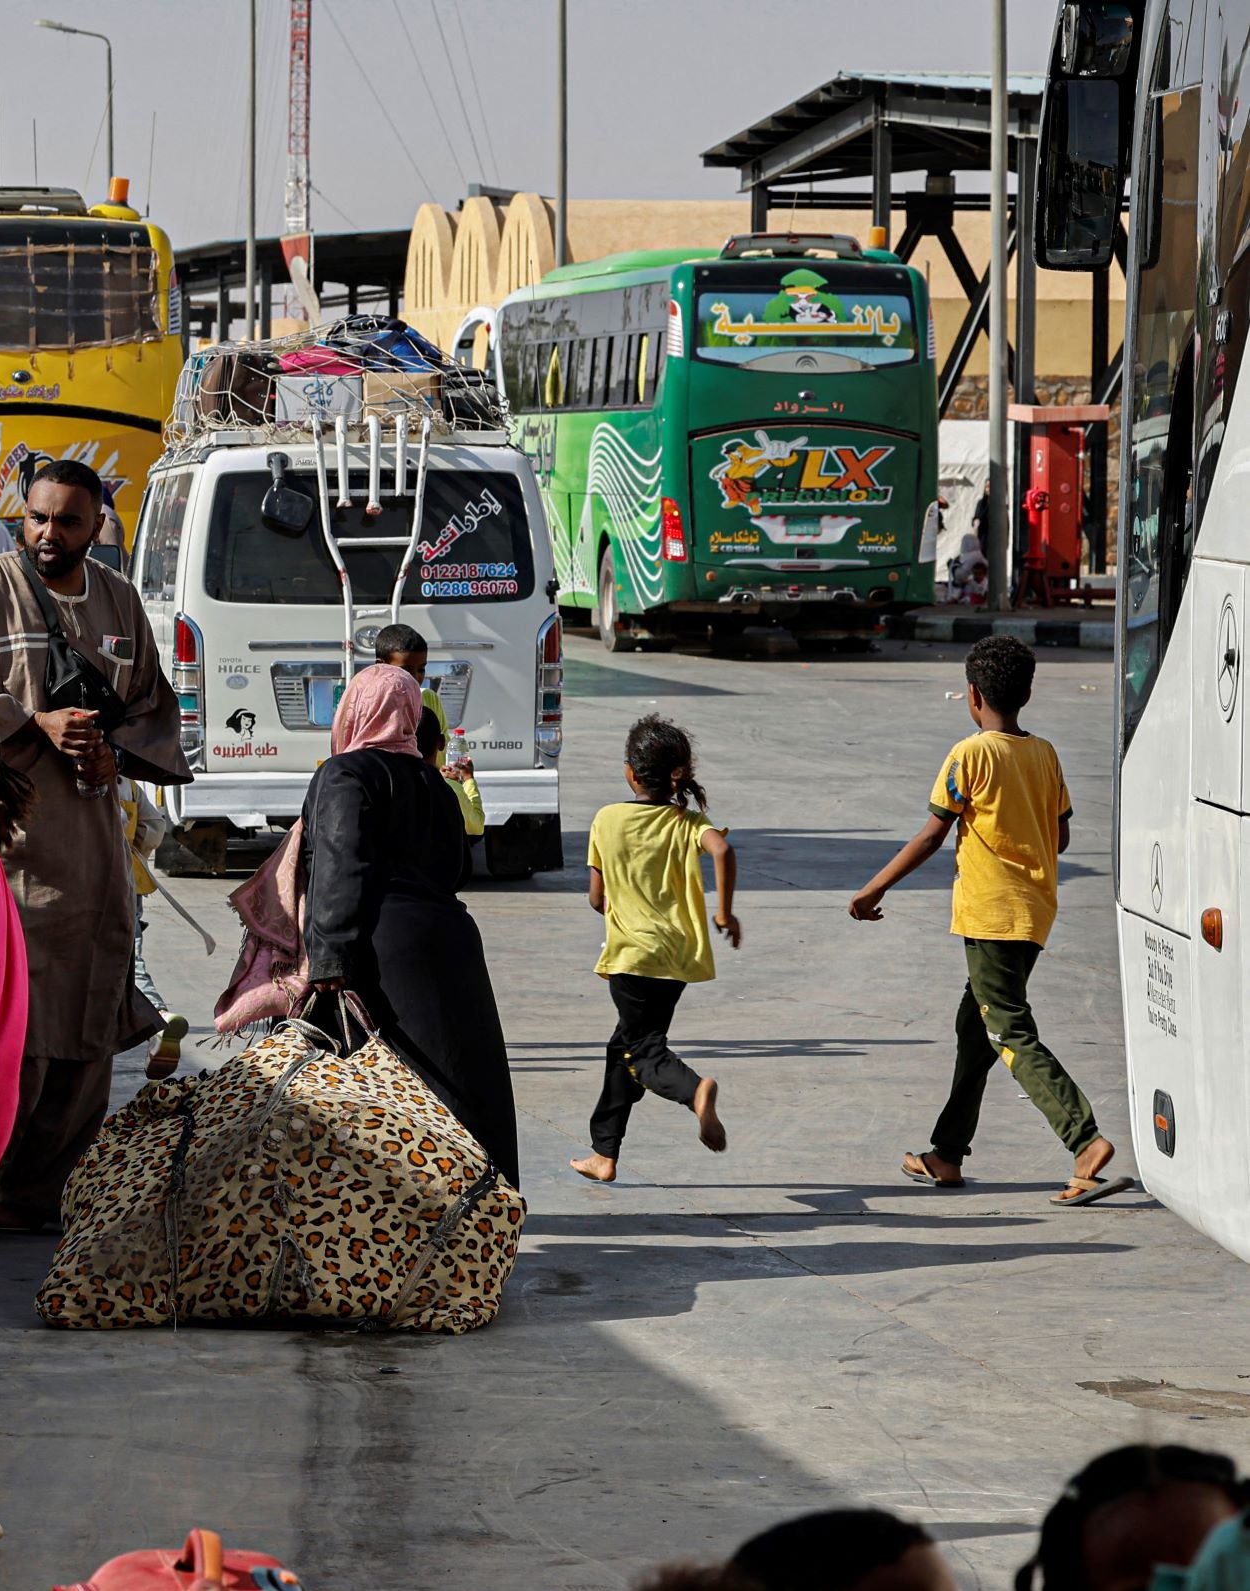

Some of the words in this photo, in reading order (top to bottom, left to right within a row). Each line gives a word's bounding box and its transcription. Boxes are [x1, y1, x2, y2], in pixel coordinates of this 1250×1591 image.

[746, 489, 888, 504] PRECISION
[421, 563, 516, 579] 0122187624
[422, 580, 518, 597] 0128896079
[218, 665, 261, 673] HIACE
[481, 741, 523, 750] TURBO
